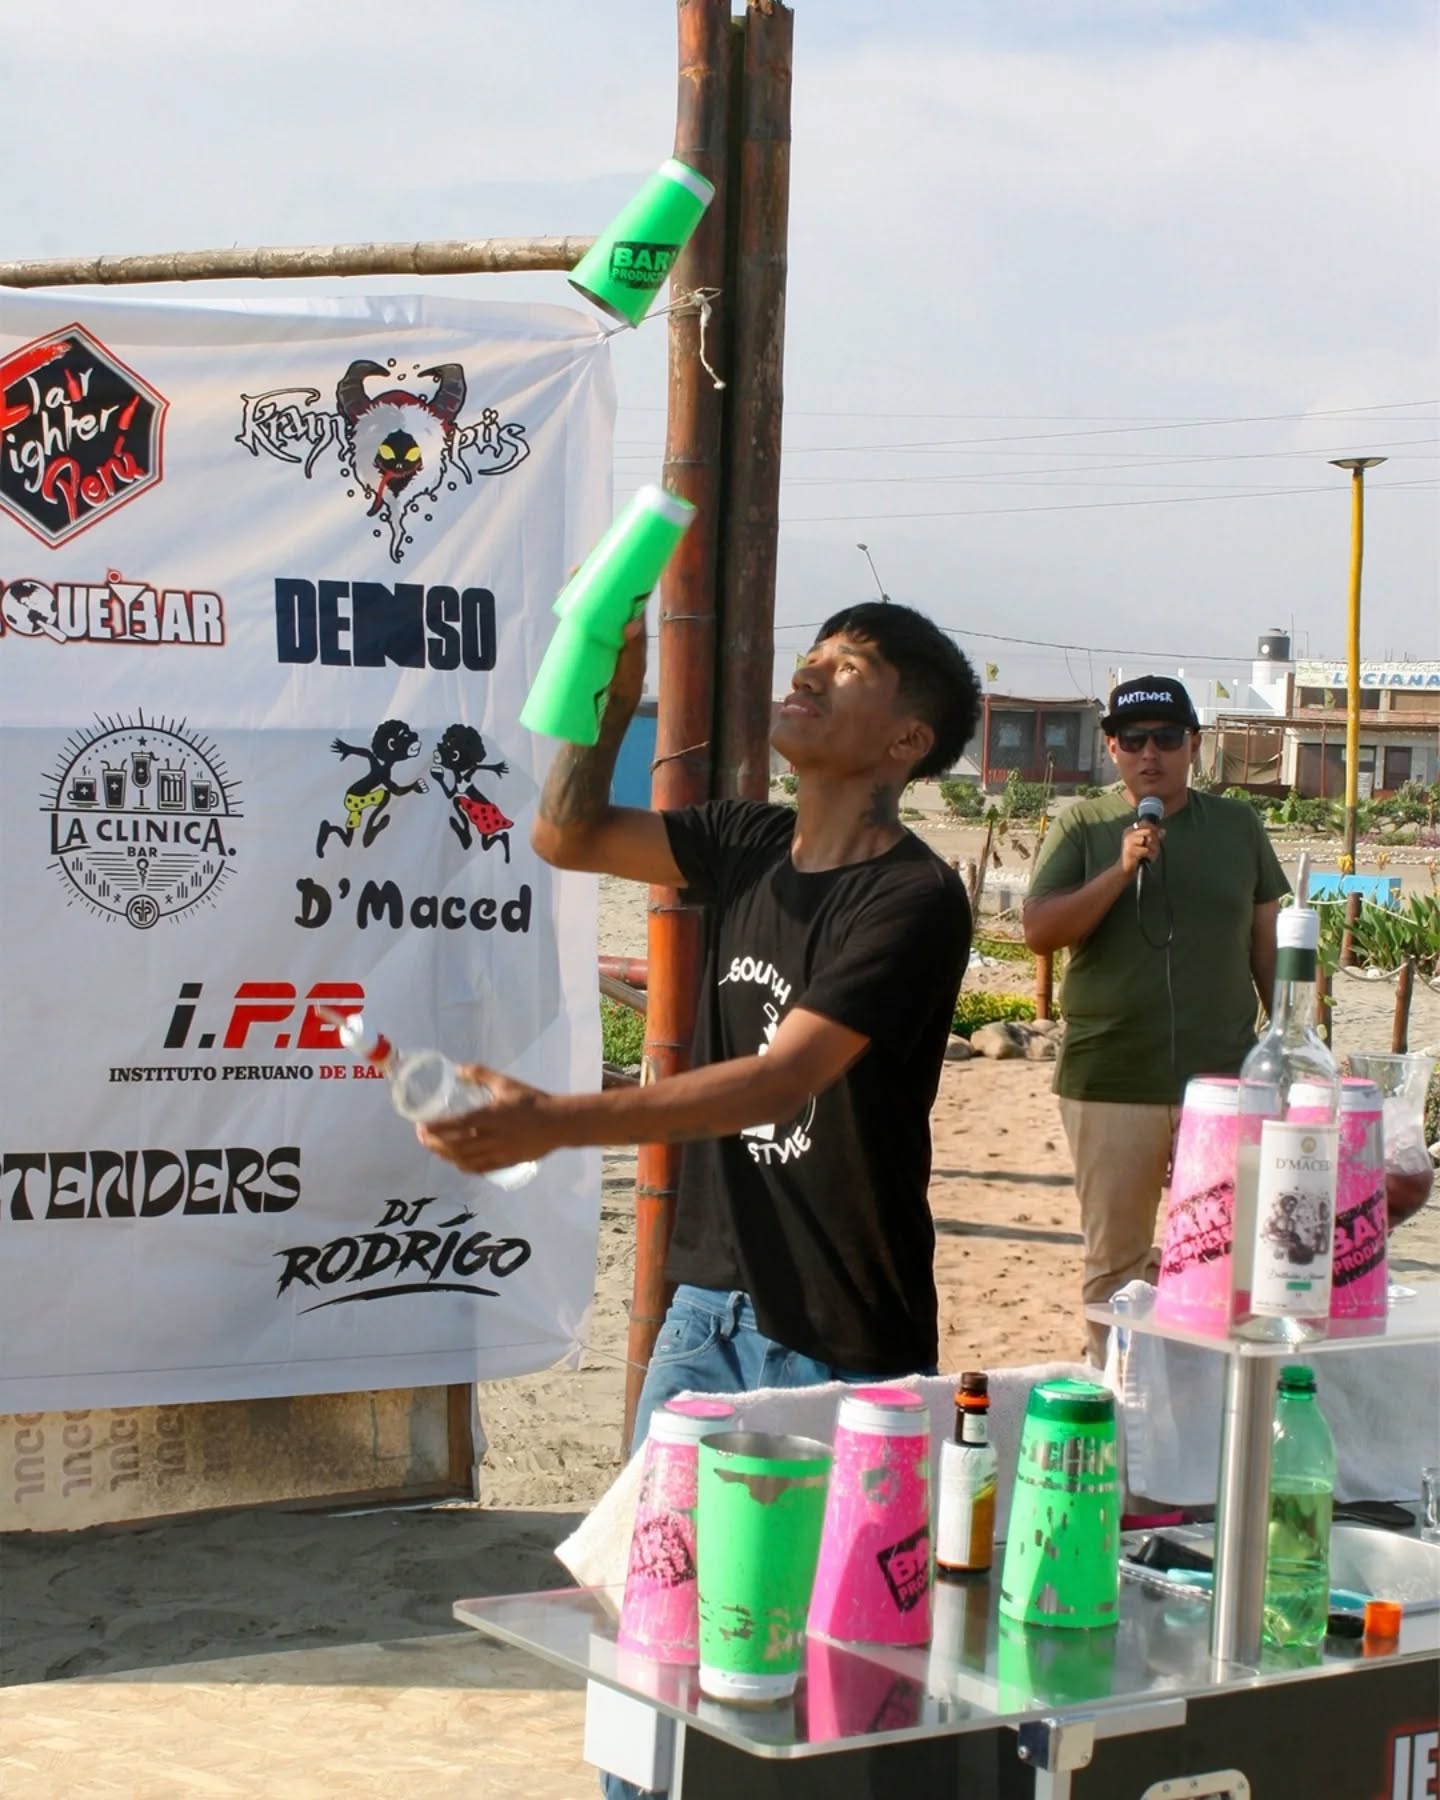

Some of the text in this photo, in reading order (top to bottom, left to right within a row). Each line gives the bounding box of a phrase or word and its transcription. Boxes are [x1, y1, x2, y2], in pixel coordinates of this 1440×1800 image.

[613, 247, 677, 271] BAR
[276, 578, 497, 671] DENSO
[1332, 672, 1440, 687] LCIANA
[1117, 691, 1174, 707] BARTENDER
[51, 813, 92, 855] LA
[127, 846, 158, 857] BAR
[729, 956, 792, 1006] SOUTH
[109, 1065, 385, 1082] INSTITUTO PERUANO DE BA
[747, 1125, 812, 1165] STYLE
[0, 1146, 301, 1221] TENDERS
[374, 1196, 438, 1228] DJ
